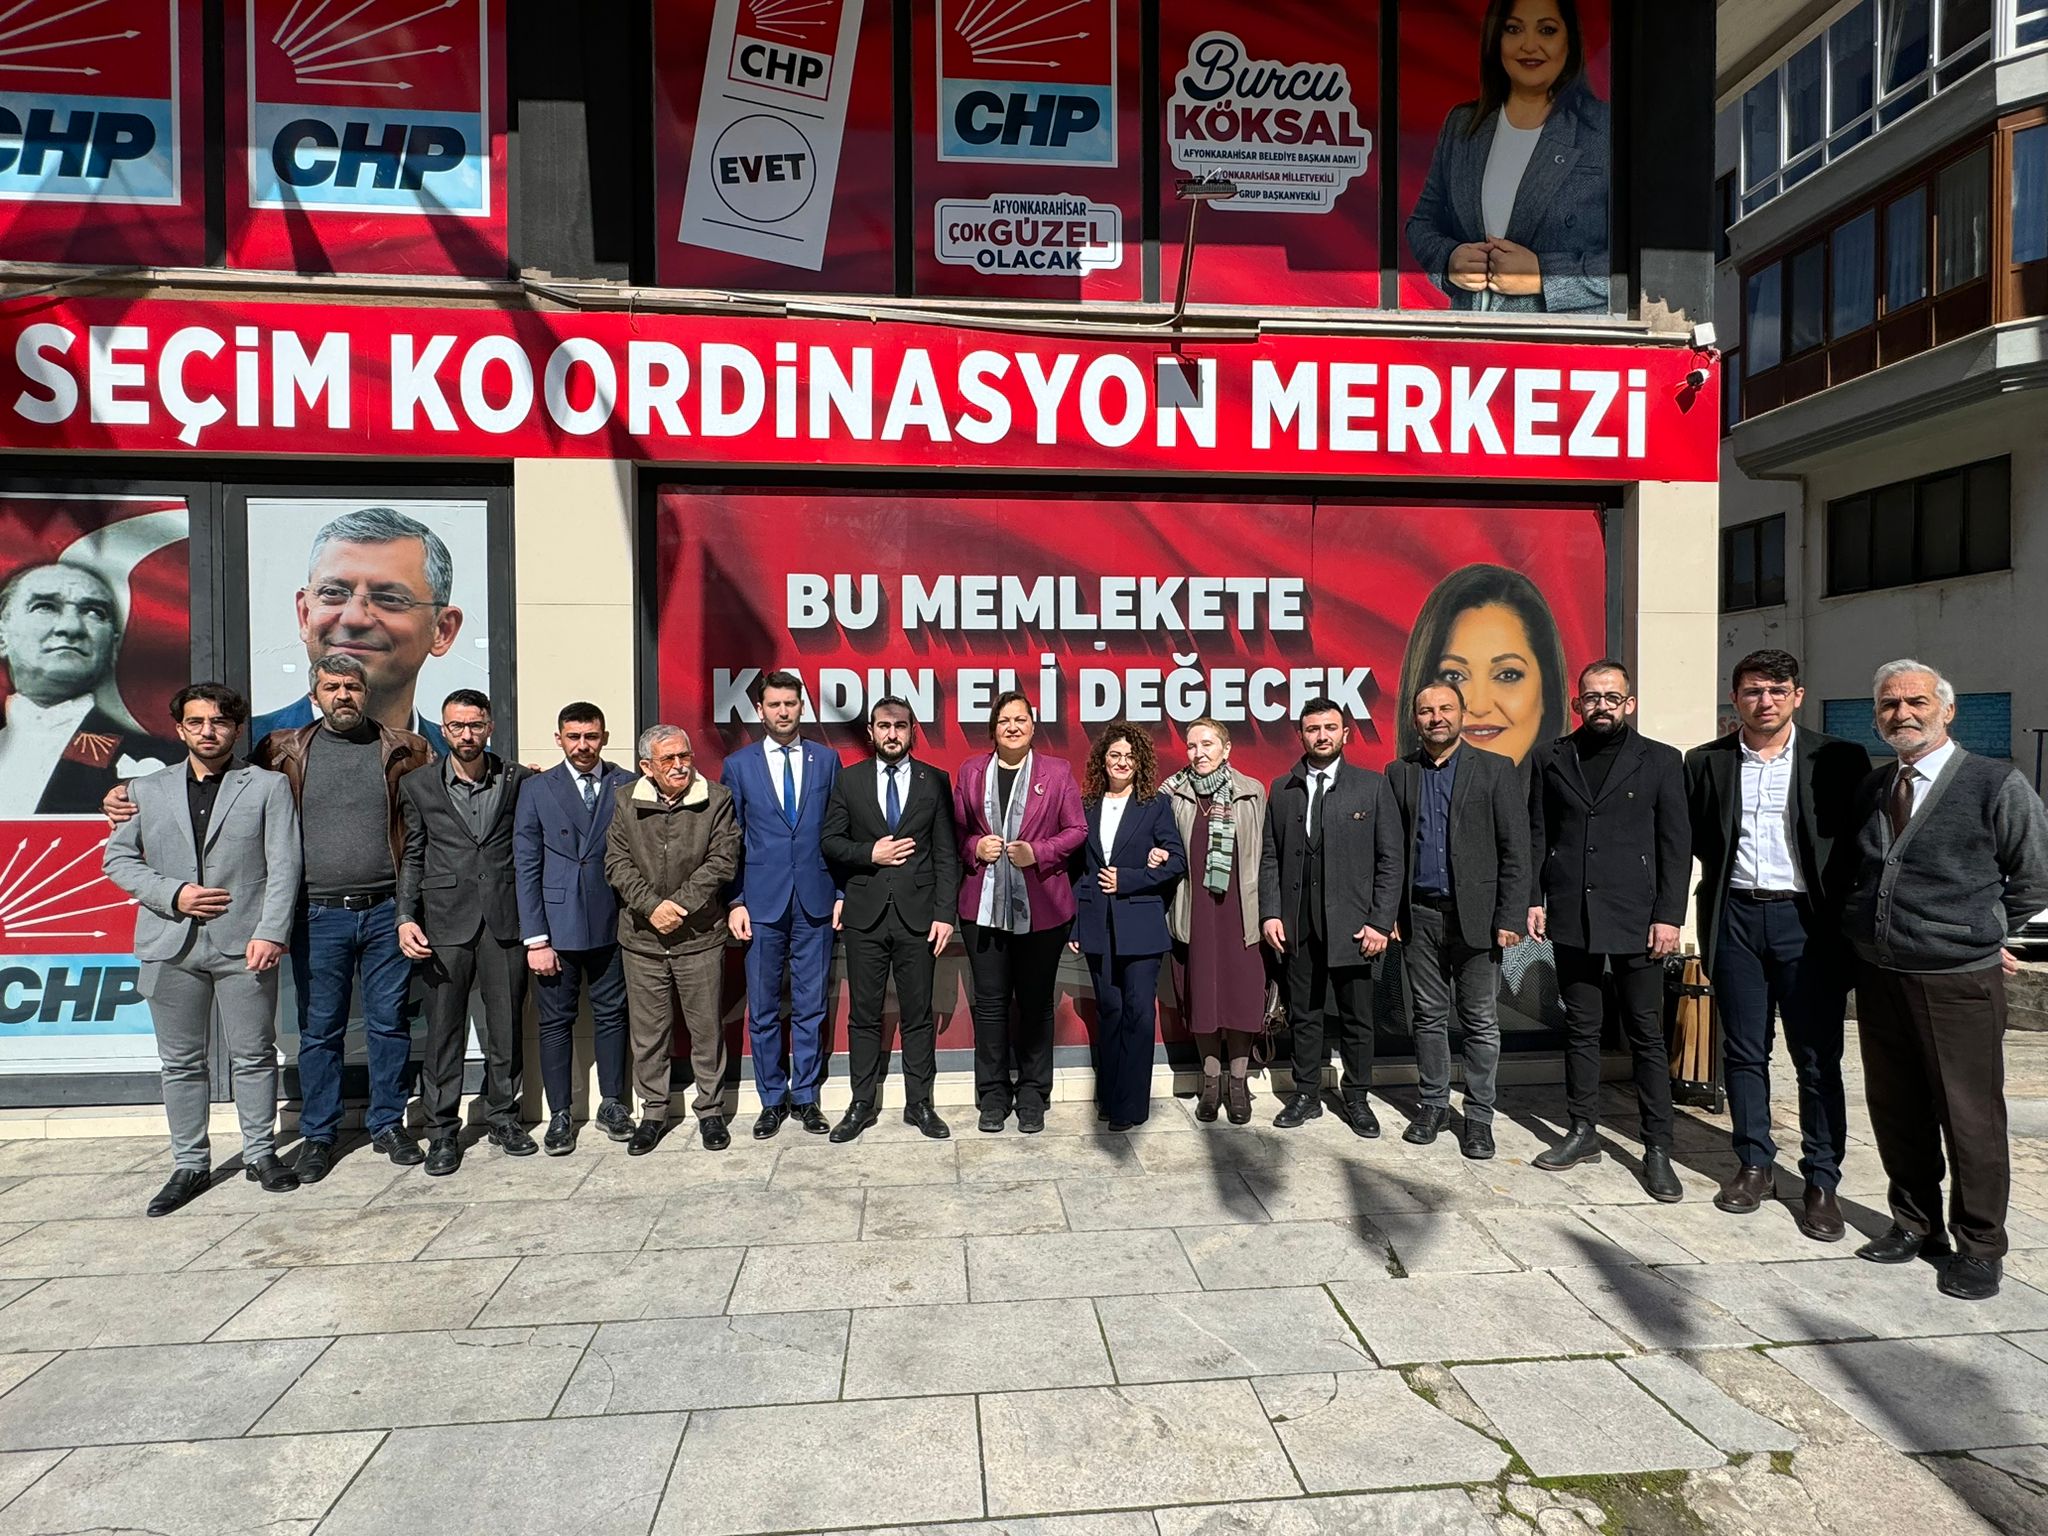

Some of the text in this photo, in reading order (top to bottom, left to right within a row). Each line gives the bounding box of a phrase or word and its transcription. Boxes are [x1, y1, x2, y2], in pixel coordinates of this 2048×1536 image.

[740, 44, 823, 88] CHP
[1183, 38, 1344, 101] Burcu
[954, 90, 1100, 147] CHP
[1174, 99, 1365, 147] KÖKSAL
[272, 118, 467, 191] CHP
[719, 153, 806, 184] EVET
[1183, 148, 1357, 164] AFYONKARAHİSAR BELEDİYE BAŞKAN ADAYI
[1239, 189, 1321, 201] GRUP BAŞKANVEKİLİ
[1282, 171, 1334, 183] MİLLETVEKİLİ
[992, 198, 1087, 216] AFYONKARAHİSAR
[948, 217, 1109, 248] ÇOK GÜZEL
[977, 249, 1083, 270] OLACAK
[14, 322, 1647, 458] SEÇİM KOORDİNASYON MERKEZİ
[786, 573, 1304, 630] BU MEMLEKETE
[0, 966, 146, 1024] CHP
